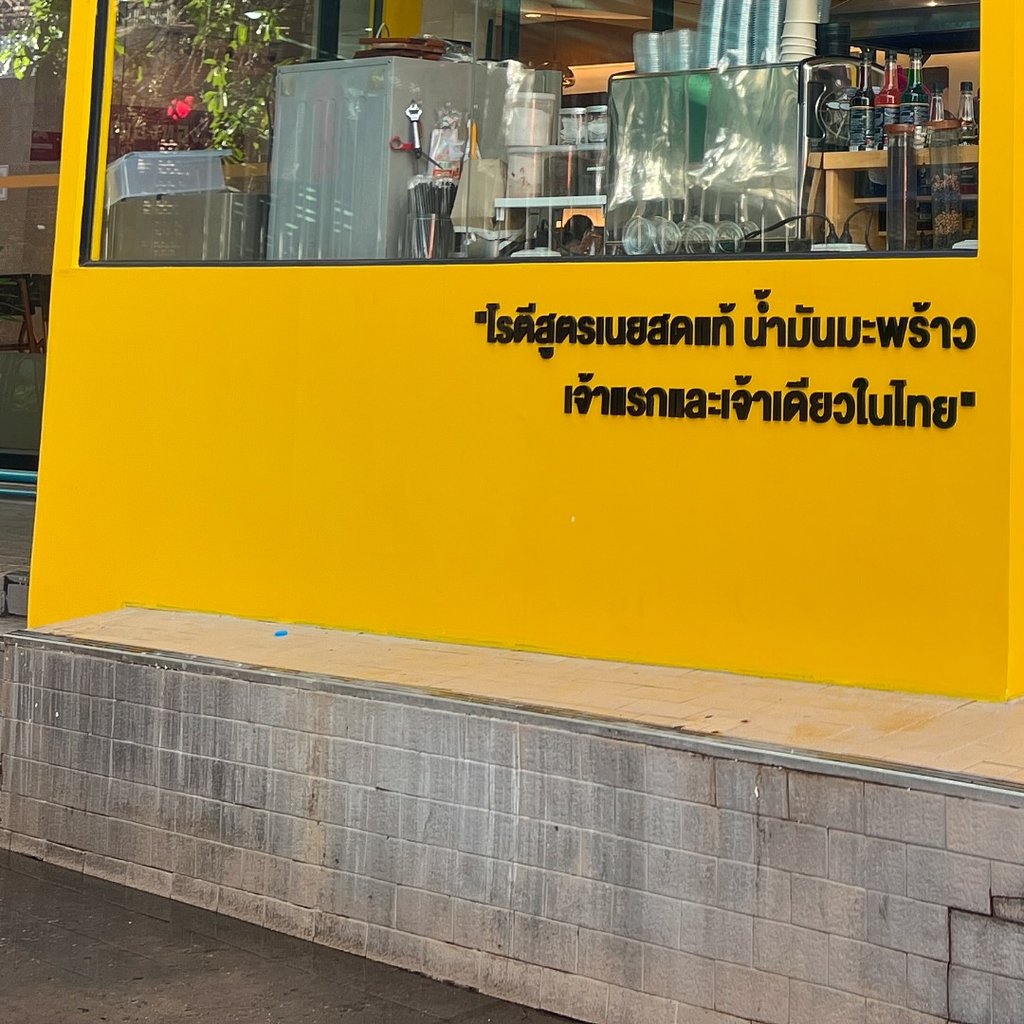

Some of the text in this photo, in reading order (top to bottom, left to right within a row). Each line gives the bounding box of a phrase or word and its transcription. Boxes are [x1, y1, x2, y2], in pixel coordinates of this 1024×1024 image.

[744, 289, 977, 351] น้ำมันมะพร้าว
